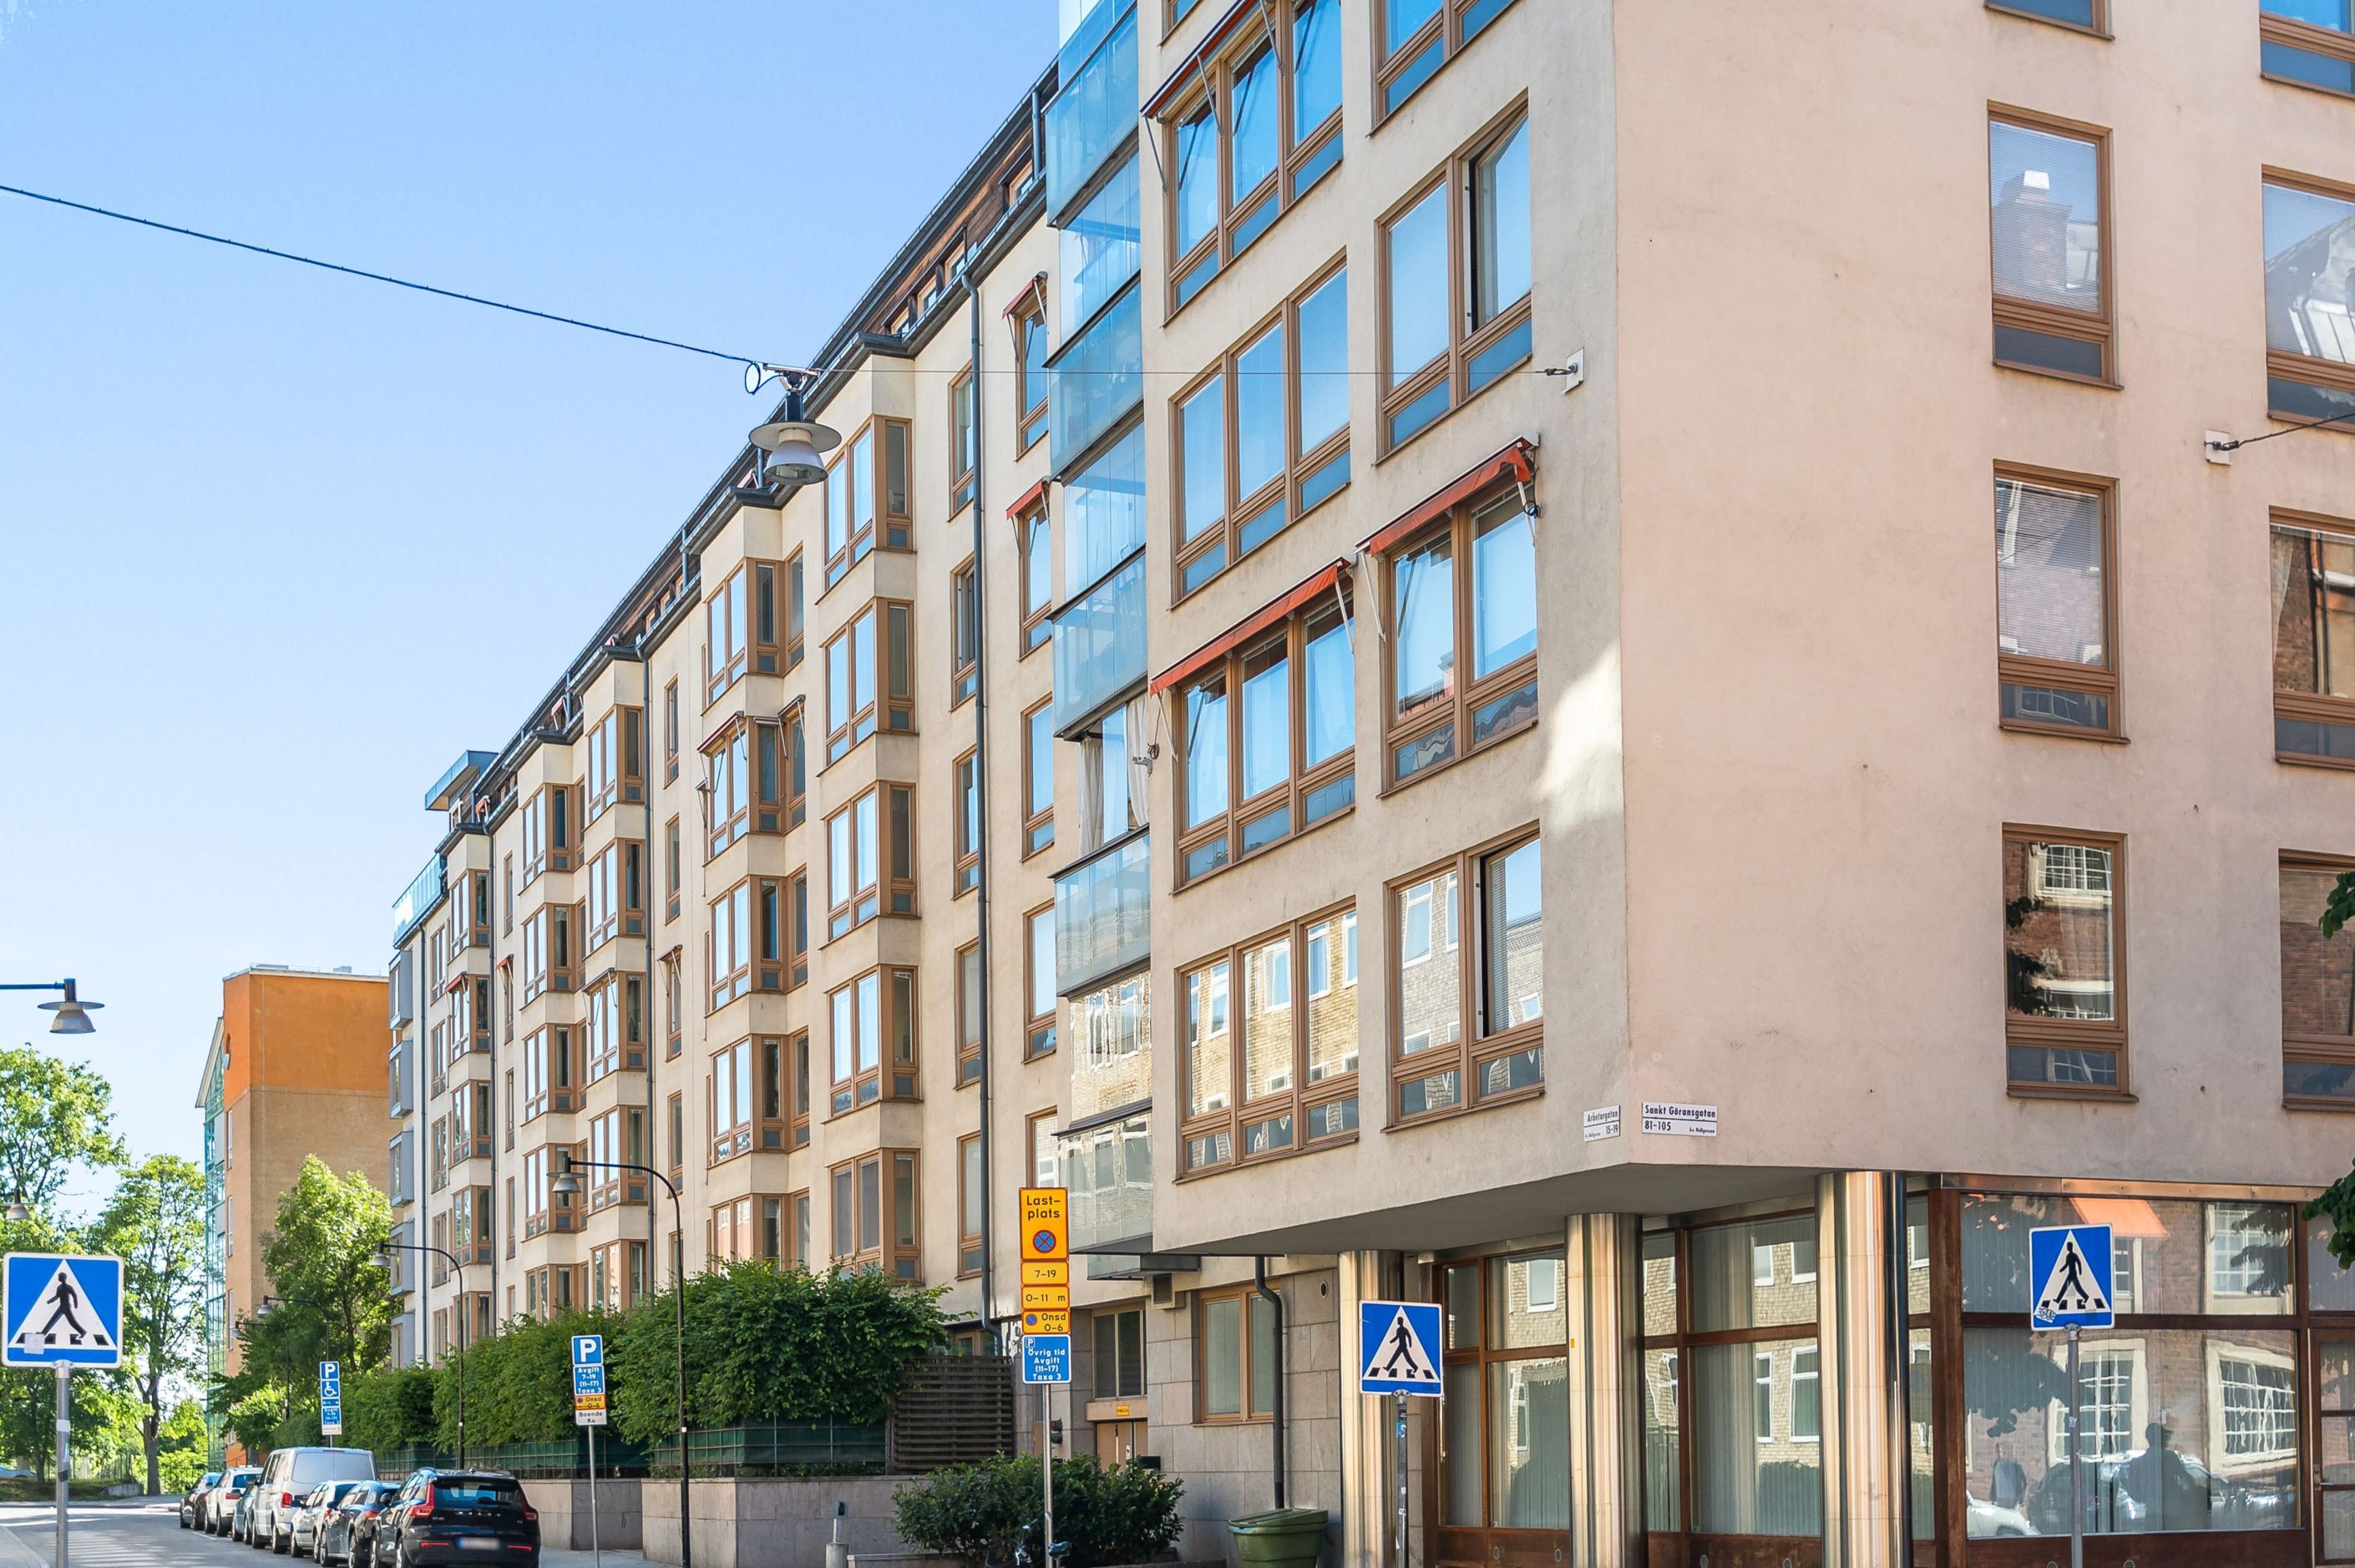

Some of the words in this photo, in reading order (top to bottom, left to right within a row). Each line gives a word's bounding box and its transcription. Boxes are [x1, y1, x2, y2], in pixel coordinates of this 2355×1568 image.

[1645, 1105, 1666, 1115] Sankt
[1669, 1106, 1715, 1119] Göransgatan
[1606, 1124, 1618, 1135] 15-19
[1644, 1120, 1671, 1130] 81-105
[1026, 1196, 1061, 1206] Last-
[1028, 1208, 1060, 1221] plats
[1035, 1270, 1056, 1278] 7-19
[1041, 1313, 1066, 1321] Onsd
[1044, 1323, 1064, 1332] 0-6
[580, 1338, 597, 1363] P
[1027, 1348, 1051, 1358] Övrig
[1034, 1357, 1060, 1365] Avgift
[1035, 1364, 1059, 1373] (11-17)
